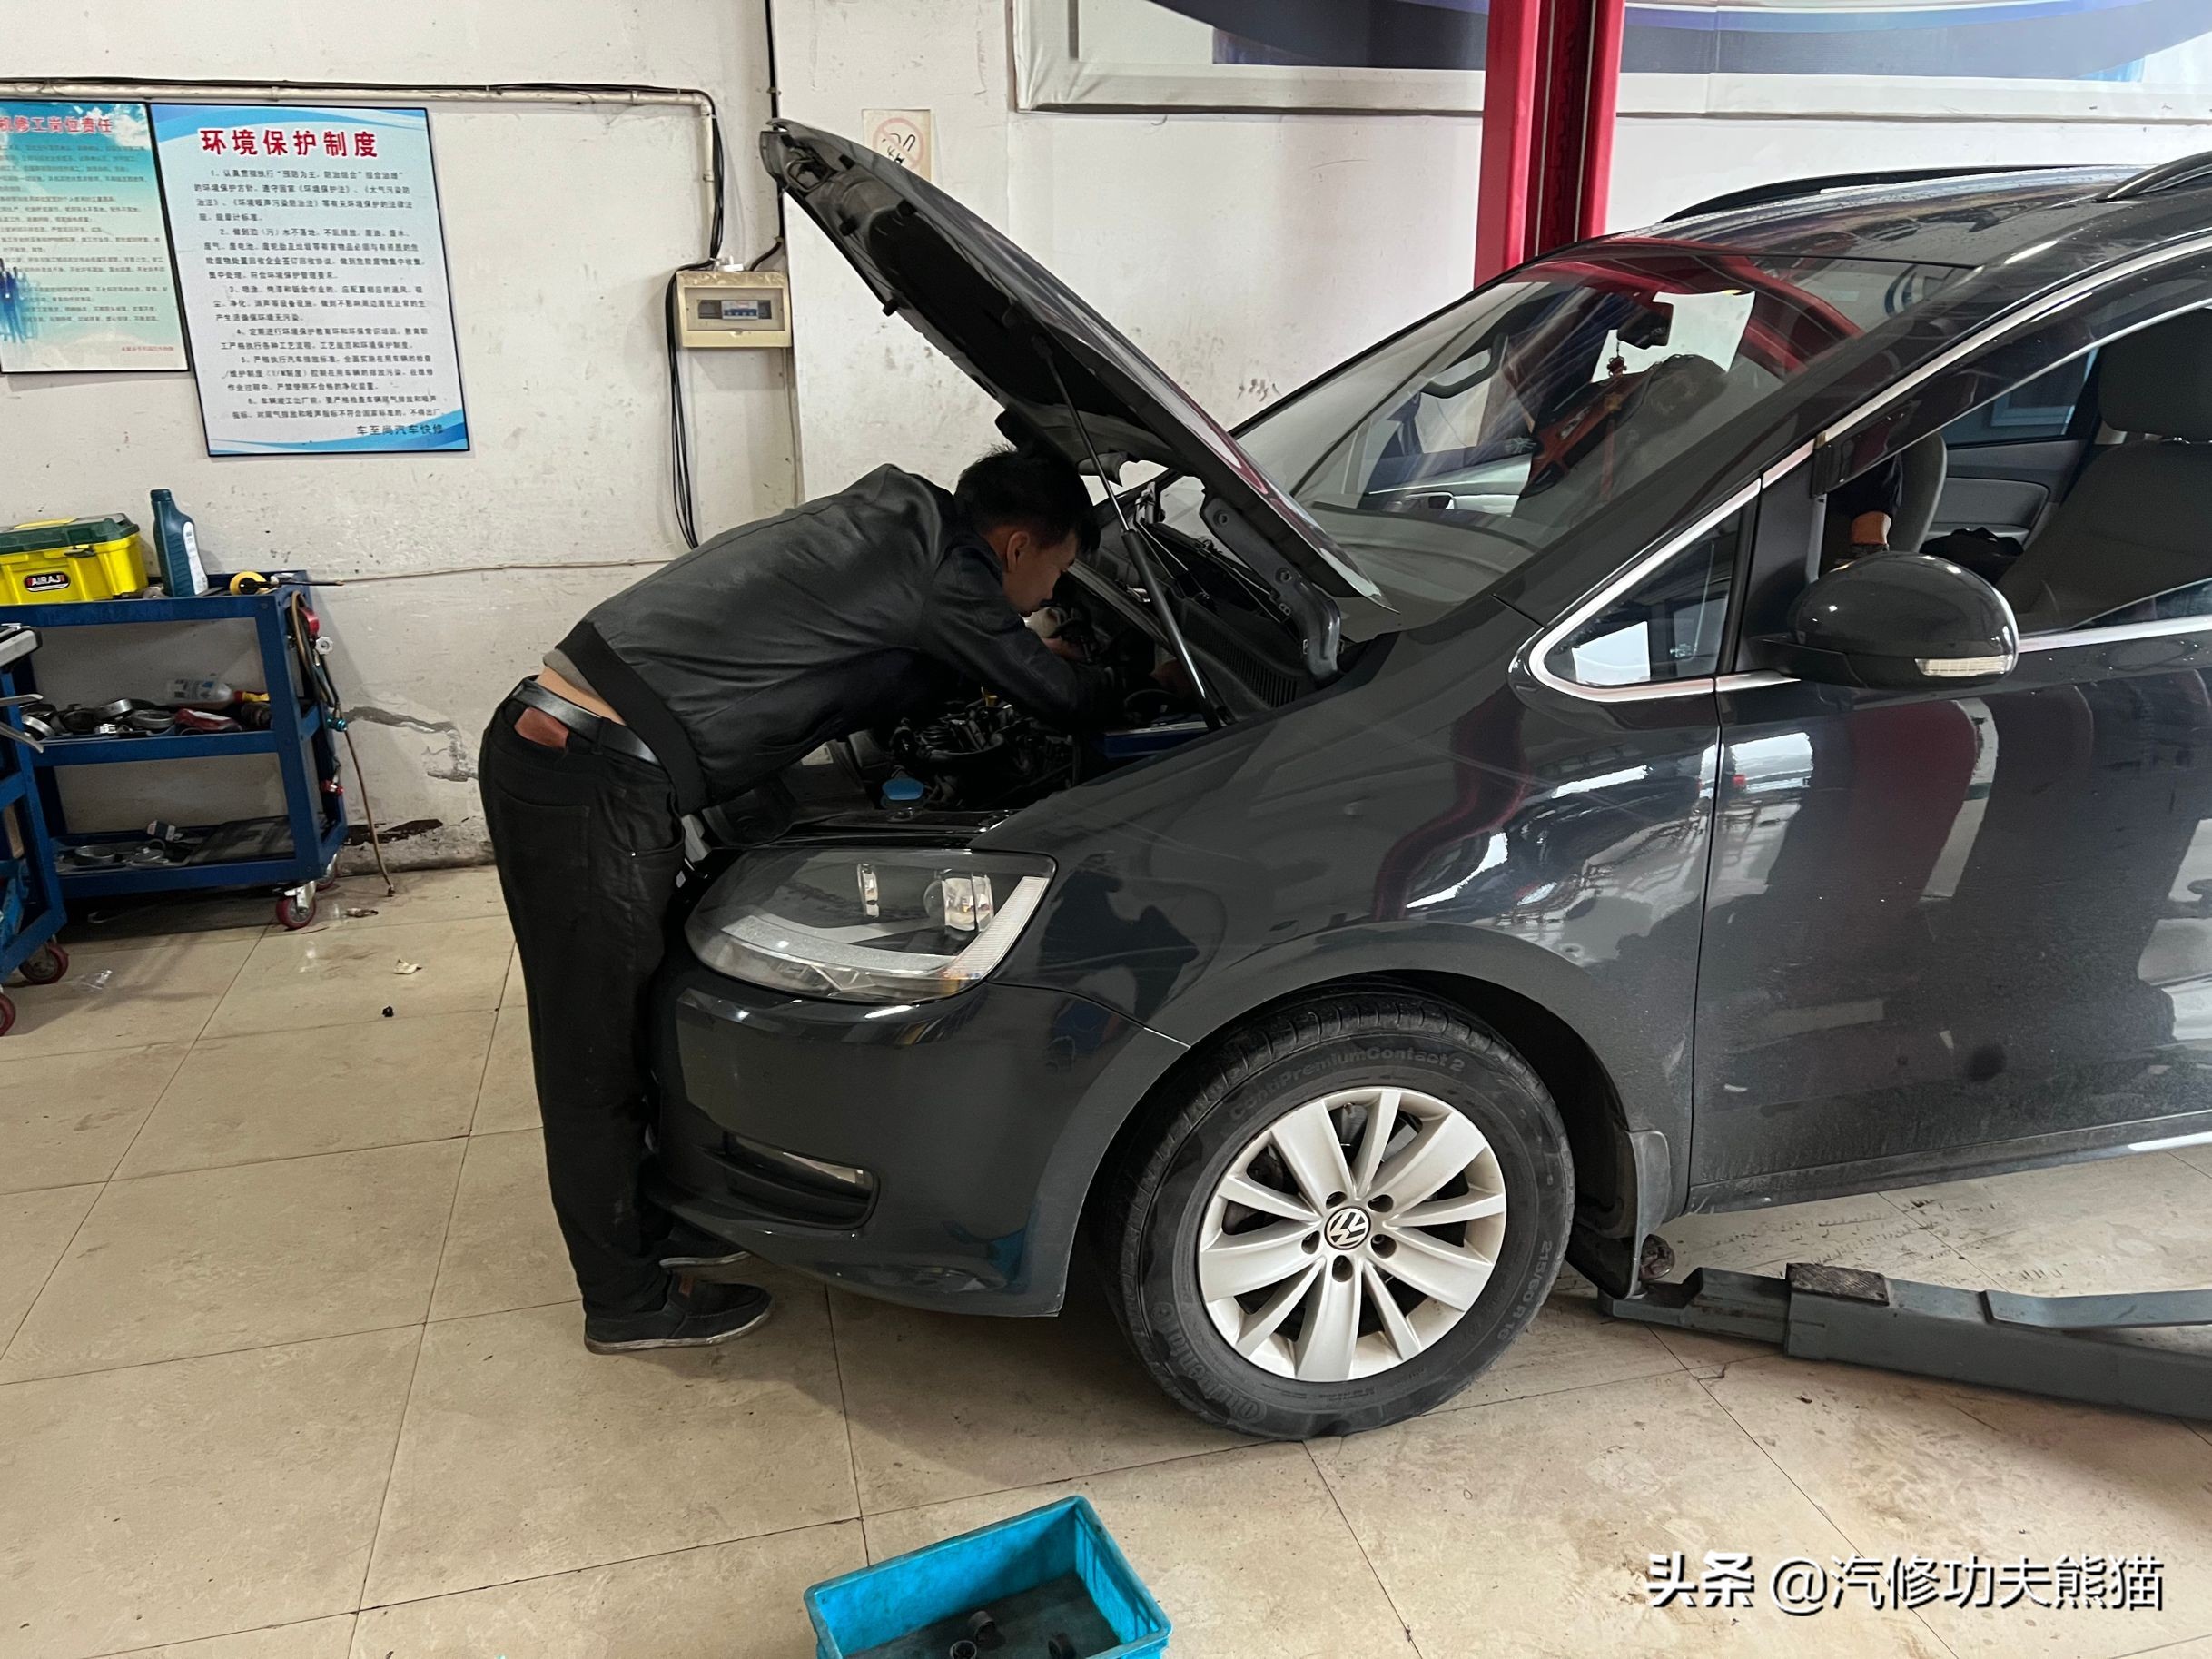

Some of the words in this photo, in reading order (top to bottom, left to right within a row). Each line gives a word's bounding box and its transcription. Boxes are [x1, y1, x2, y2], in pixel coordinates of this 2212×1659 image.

[200, 129, 378, 157] 环境保护制度
[1449, 1057, 1466, 1073] 2
